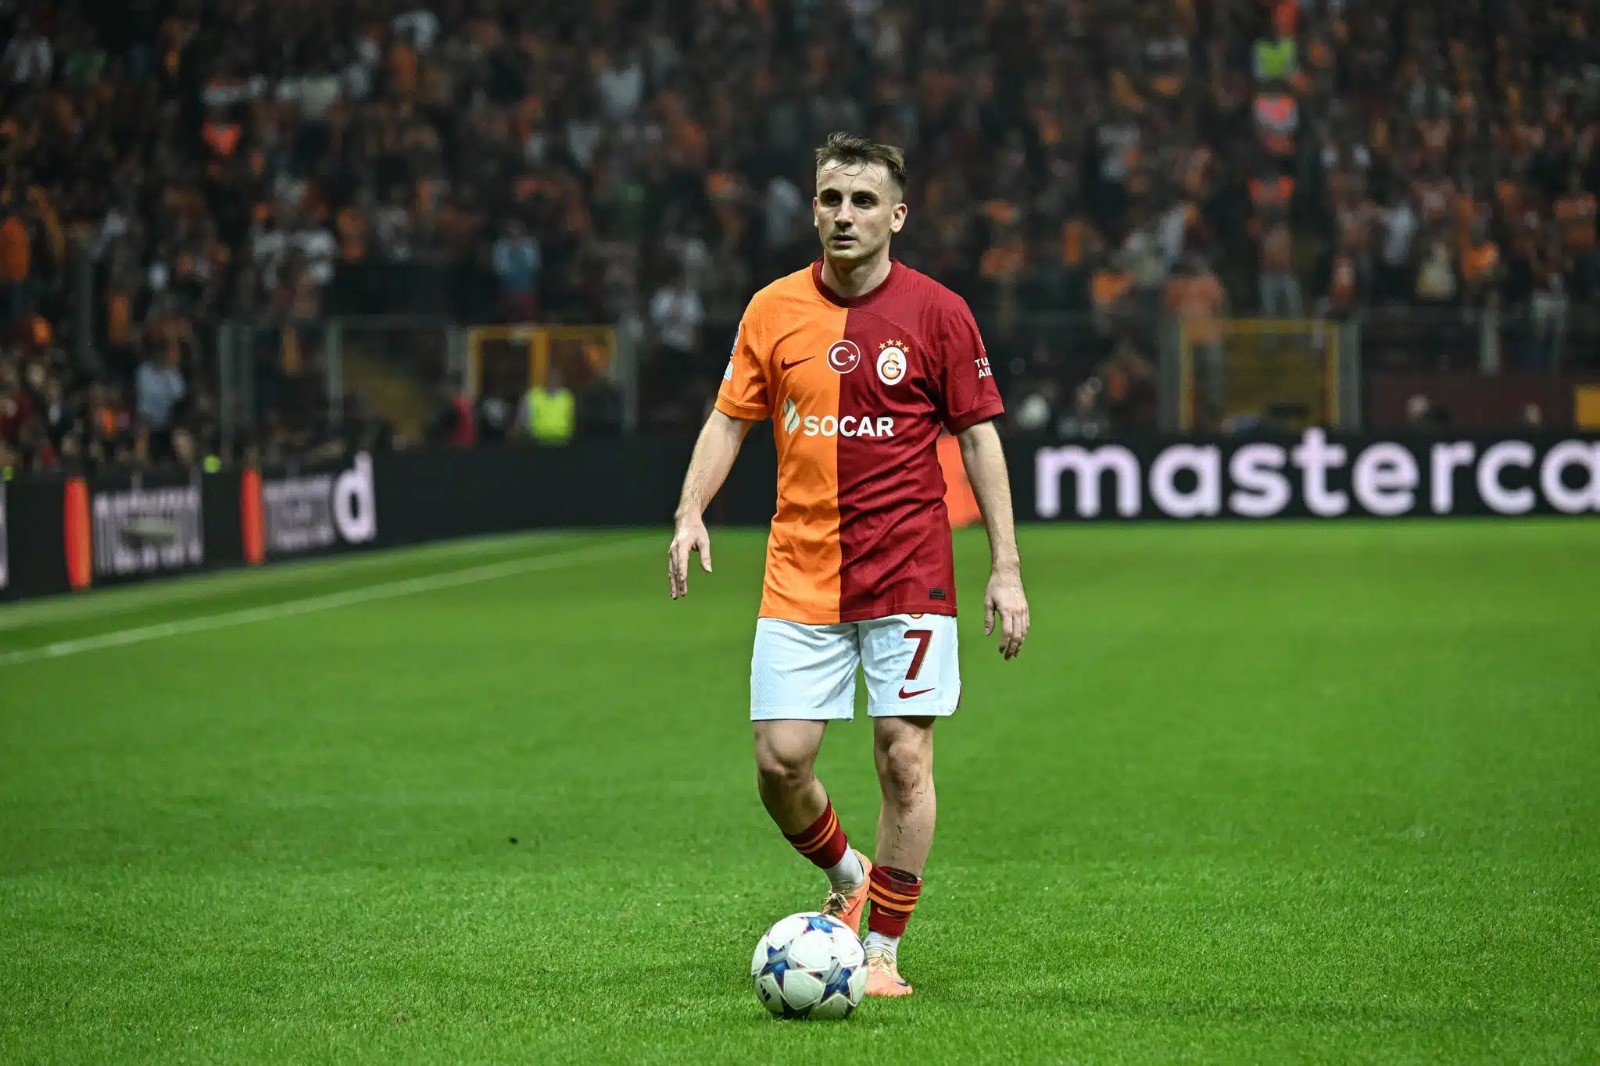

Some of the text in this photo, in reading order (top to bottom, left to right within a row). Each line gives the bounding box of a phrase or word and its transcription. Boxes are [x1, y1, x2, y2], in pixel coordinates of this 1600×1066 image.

[974, 356, 990, 369] TU
[803, 415, 895, 438] SOCAR
[1035, 428, 1600, 519] masterca
[903, 629, 933, 681] 7
